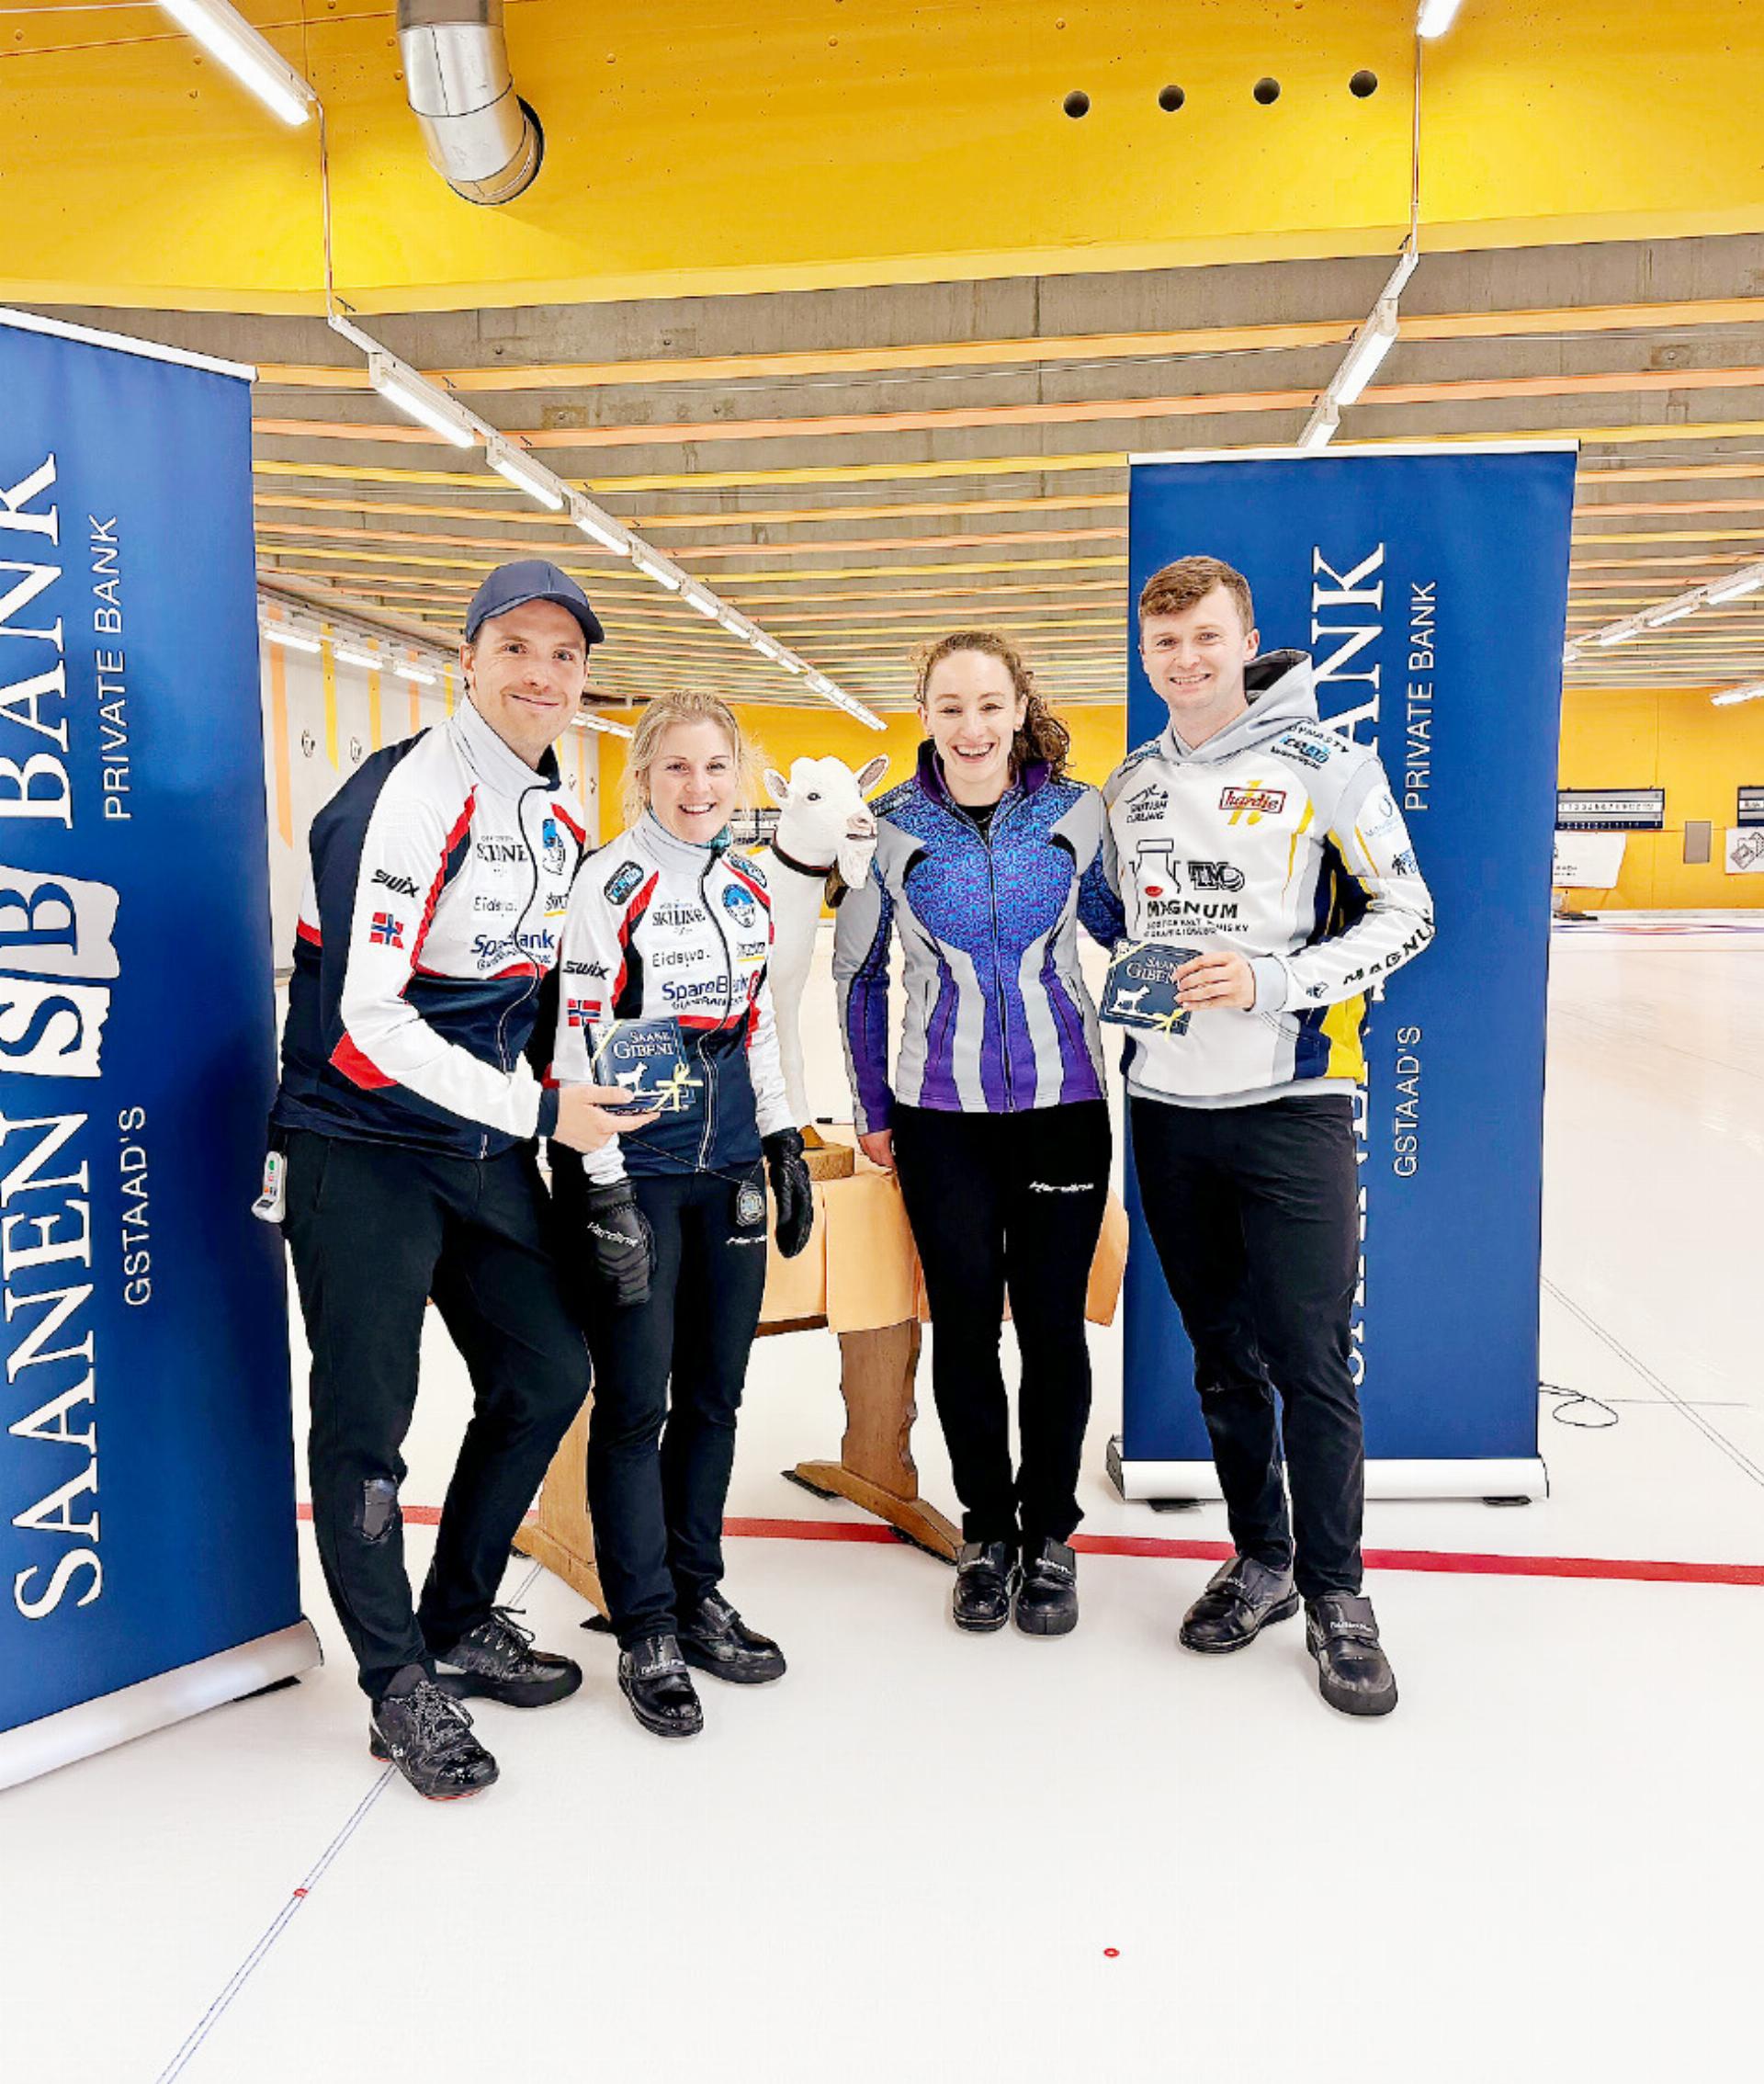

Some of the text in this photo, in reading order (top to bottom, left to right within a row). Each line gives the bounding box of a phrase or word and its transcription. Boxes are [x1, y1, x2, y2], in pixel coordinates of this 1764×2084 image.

[0, 451, 73, 830] BANK
[1311, 541, 1385, 756] ANK
[88, 513, 152, 1307] GSTAAD'S PRIVATE BANK
[1125, 961, 1181, 985] GIBEN
[1145, 956, 1179, 970] SAAN
[1147, 900, 1238, 919] MAGNUM
[1393, 581, 1437, 1178] GSTAAD'S PRIVATE BANK
[0, 1111, 102, 1622] SAANEN
